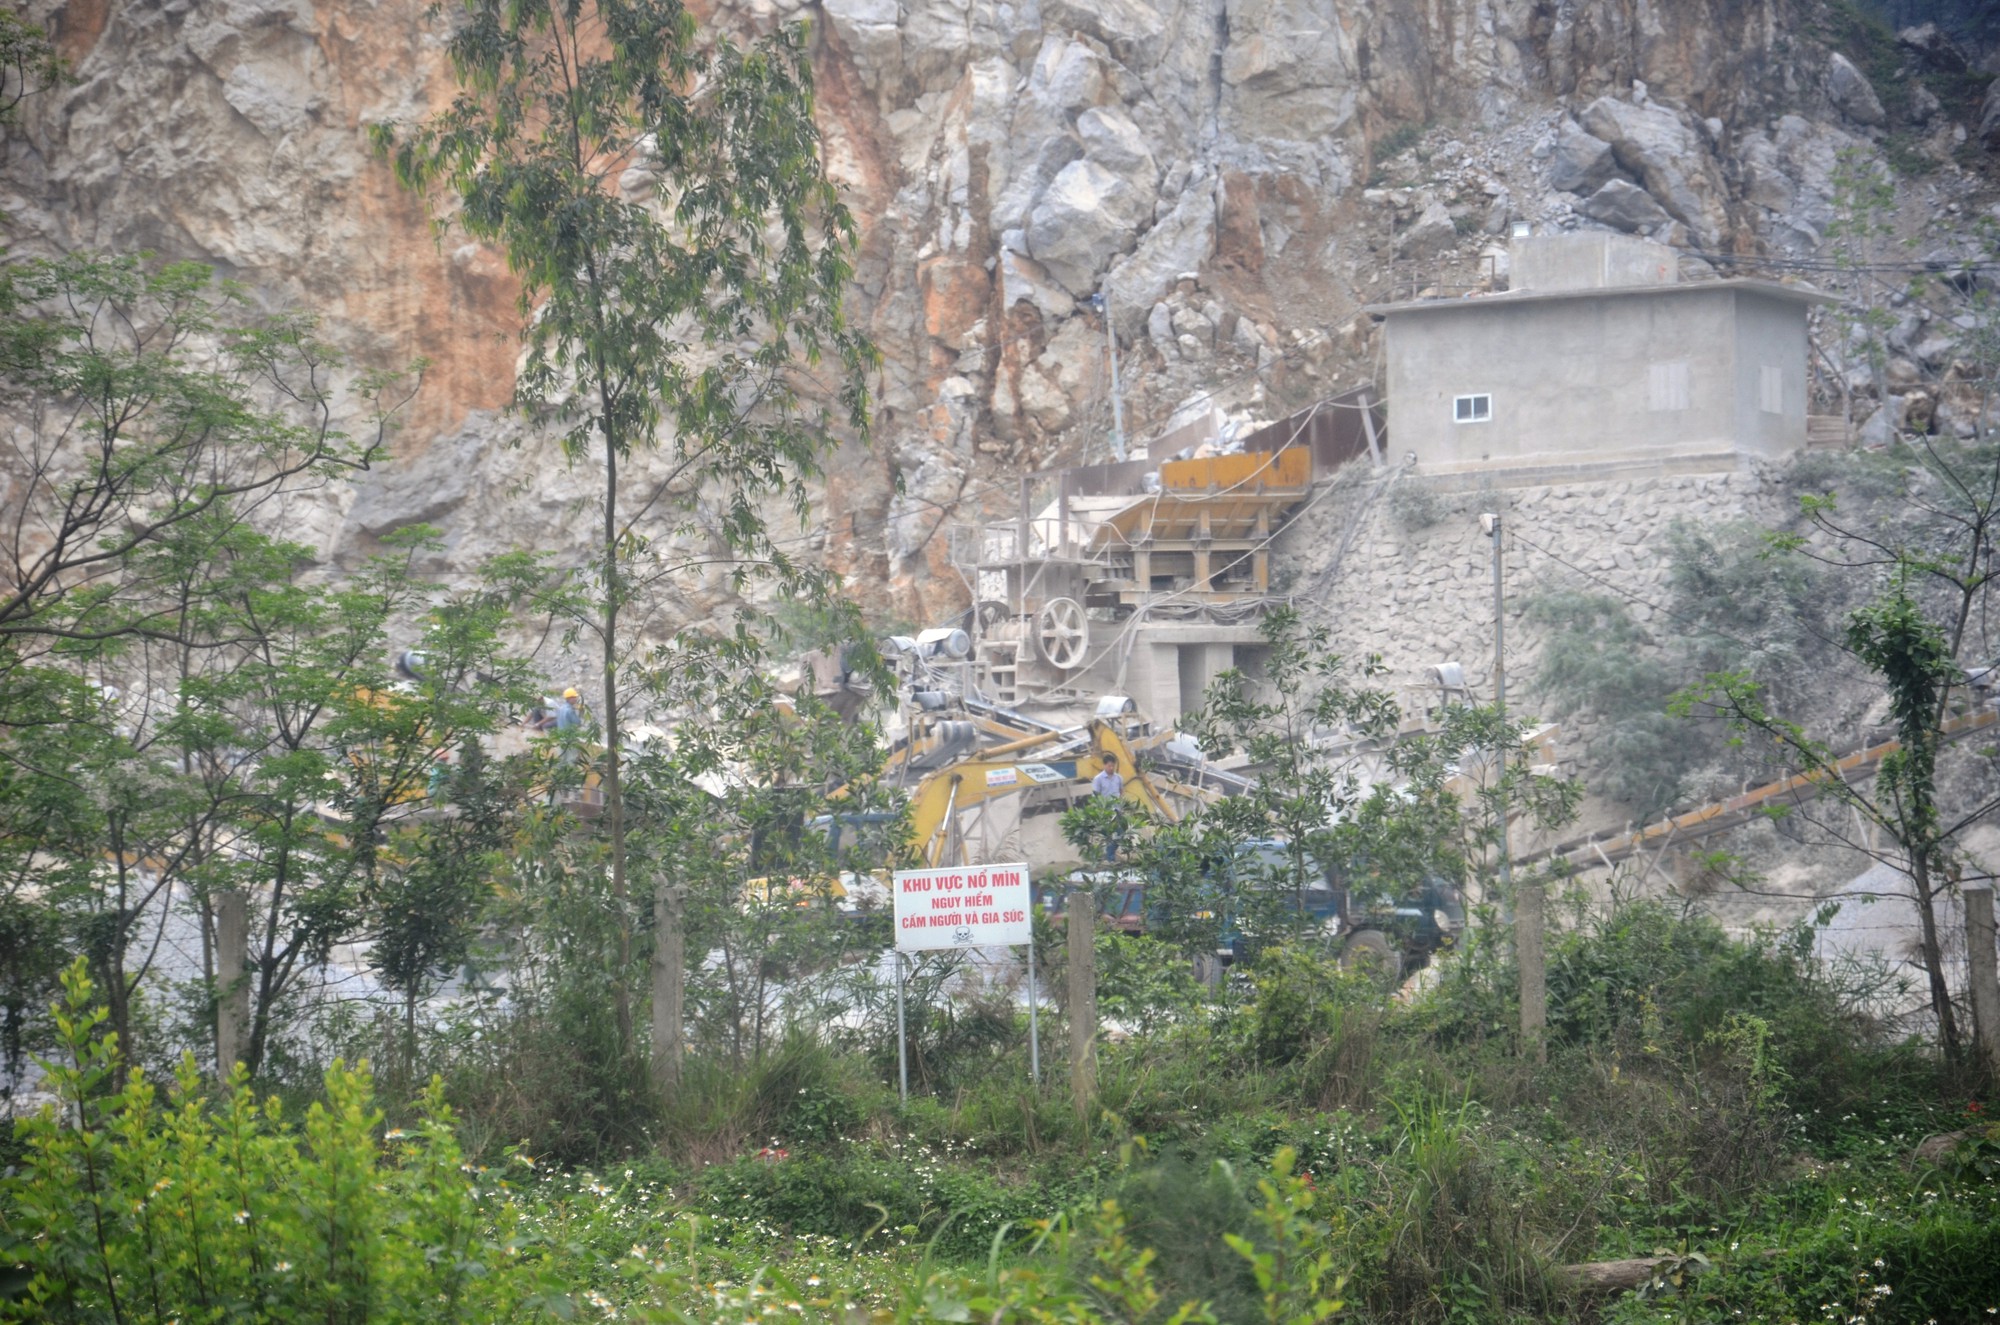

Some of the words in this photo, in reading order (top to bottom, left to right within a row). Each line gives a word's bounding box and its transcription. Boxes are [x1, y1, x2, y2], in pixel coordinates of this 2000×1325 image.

[903, 878, 931, 892] KHU
[936, 874, 963, 892] VỰC
[968, 869, 988, 888] NỔ
[992, 871, 1020, 887] MÌN
[932, 897, 961, 909] NGUY
[965, 891, 993, 907] HIỂM
[902, 913, 926, 928] CẤM
[930, 912, 962, 926] NGƯỜI
[965, 911, 979, 925] VÀ
[982, 912, 999, 924] GIA
[1003, 909, 1024, 922] SÚC
